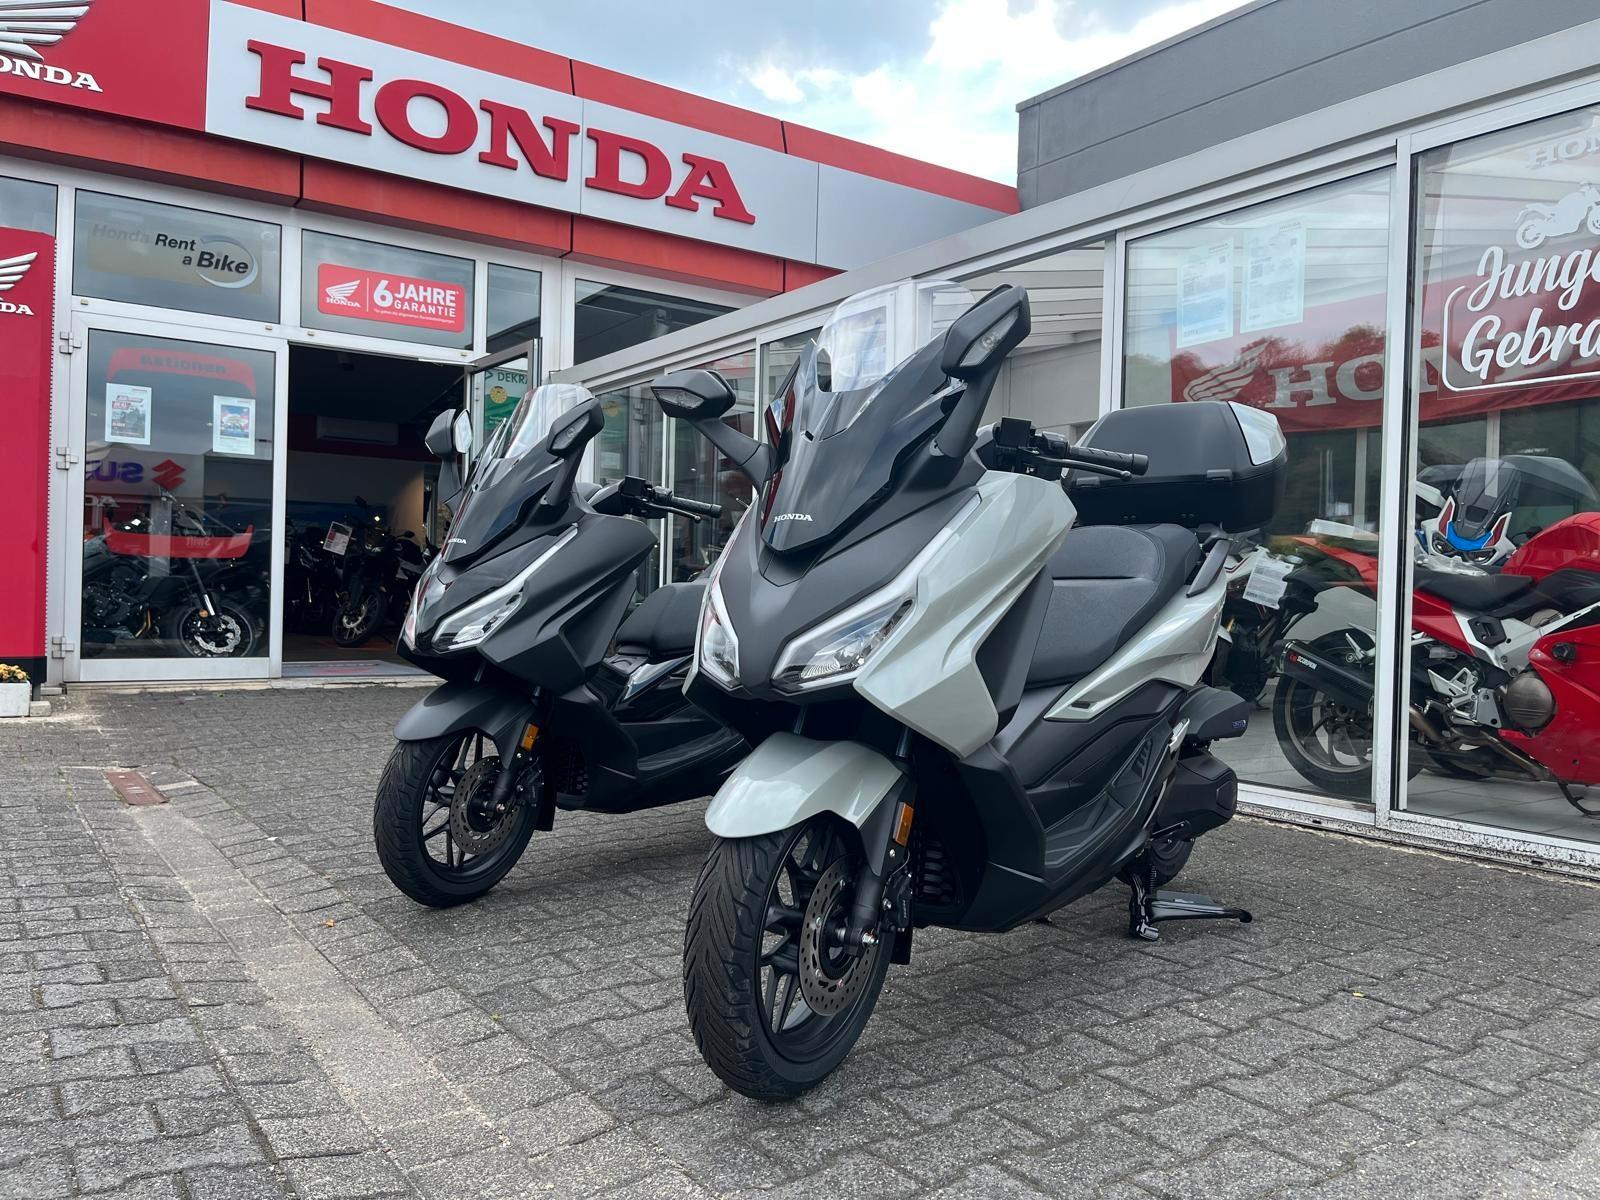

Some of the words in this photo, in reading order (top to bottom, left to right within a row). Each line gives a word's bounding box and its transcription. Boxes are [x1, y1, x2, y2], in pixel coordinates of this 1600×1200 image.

[246, 39, 756, 225] HONDA
[155, 233, 197, 251] Rent
[182, 255, 192, 265] a
[197, 251, 248, 274] Bike
[1466, 246, 1600, 312] Jung
[326, 297, 361, 308] HONDA
[373, 279, 394, 307] 6
[394, 299, 456, 317] GARANTIE
[773, 513, 813, 522] HONDA
